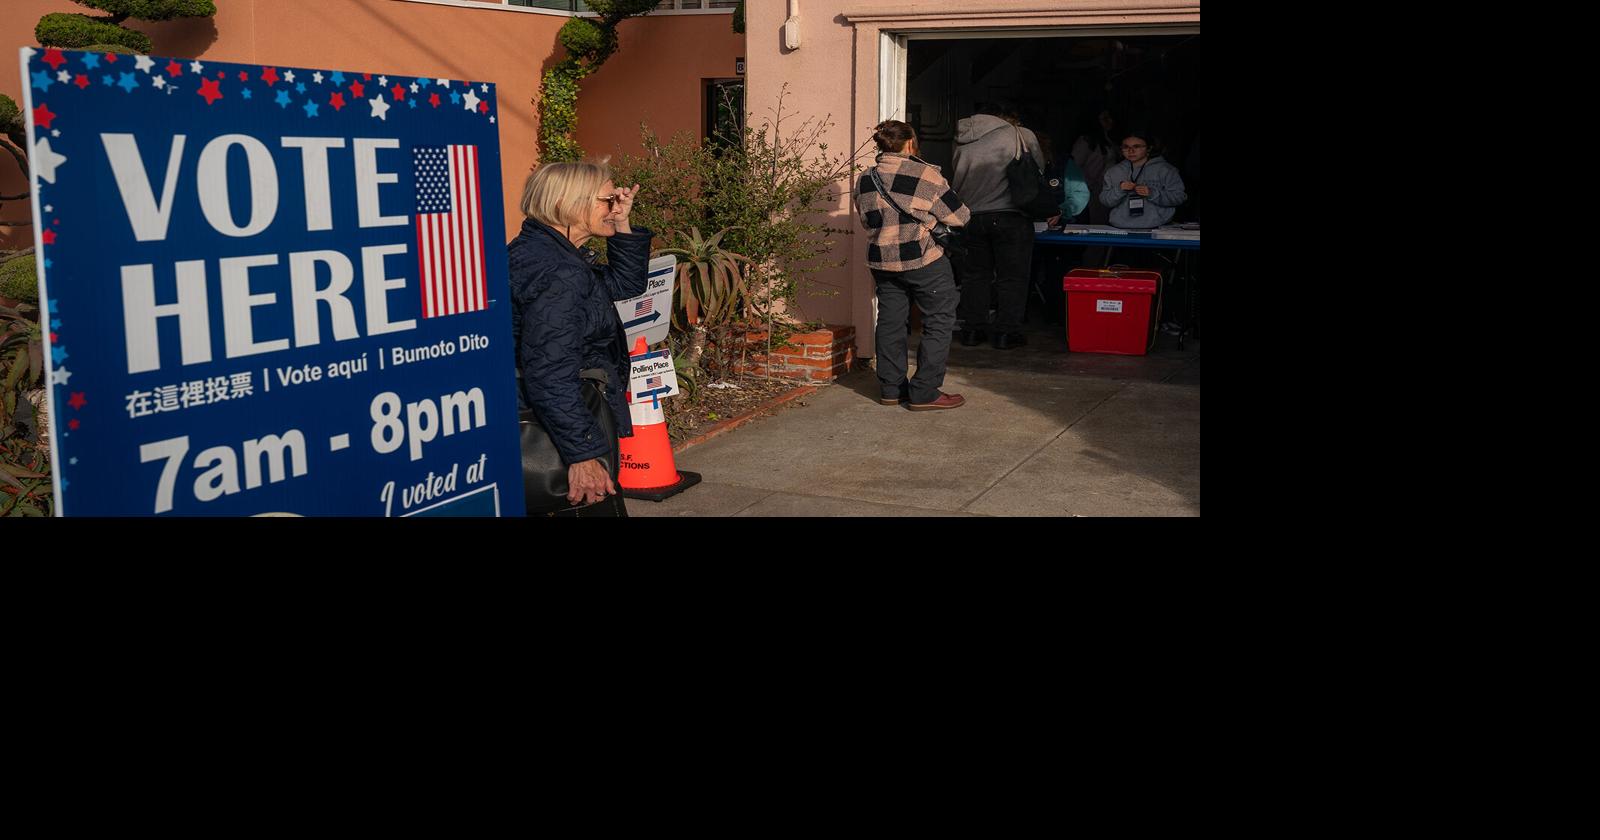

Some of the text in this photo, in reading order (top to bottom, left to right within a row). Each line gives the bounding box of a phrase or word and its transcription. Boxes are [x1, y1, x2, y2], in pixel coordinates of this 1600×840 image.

[100, 132, 409, 242] VOTE
[120, 243, 417, 374] HERE
[648, 278, 666, 290] Place
[125, 371, 253, 419] 在這裡投票
[276, 366, 322, 387] Vote
[327, 353, 368, 380] aquí
[391, 340, 456, 366] Bumoto
[459, 333, 489, 353] Dito
[632, 361, 669, 374] Polling Place
[139, 428, 308, 515] 7am
[370, 386, 487, 462] 8pm
[380, 453, 488, 517] I voted at
